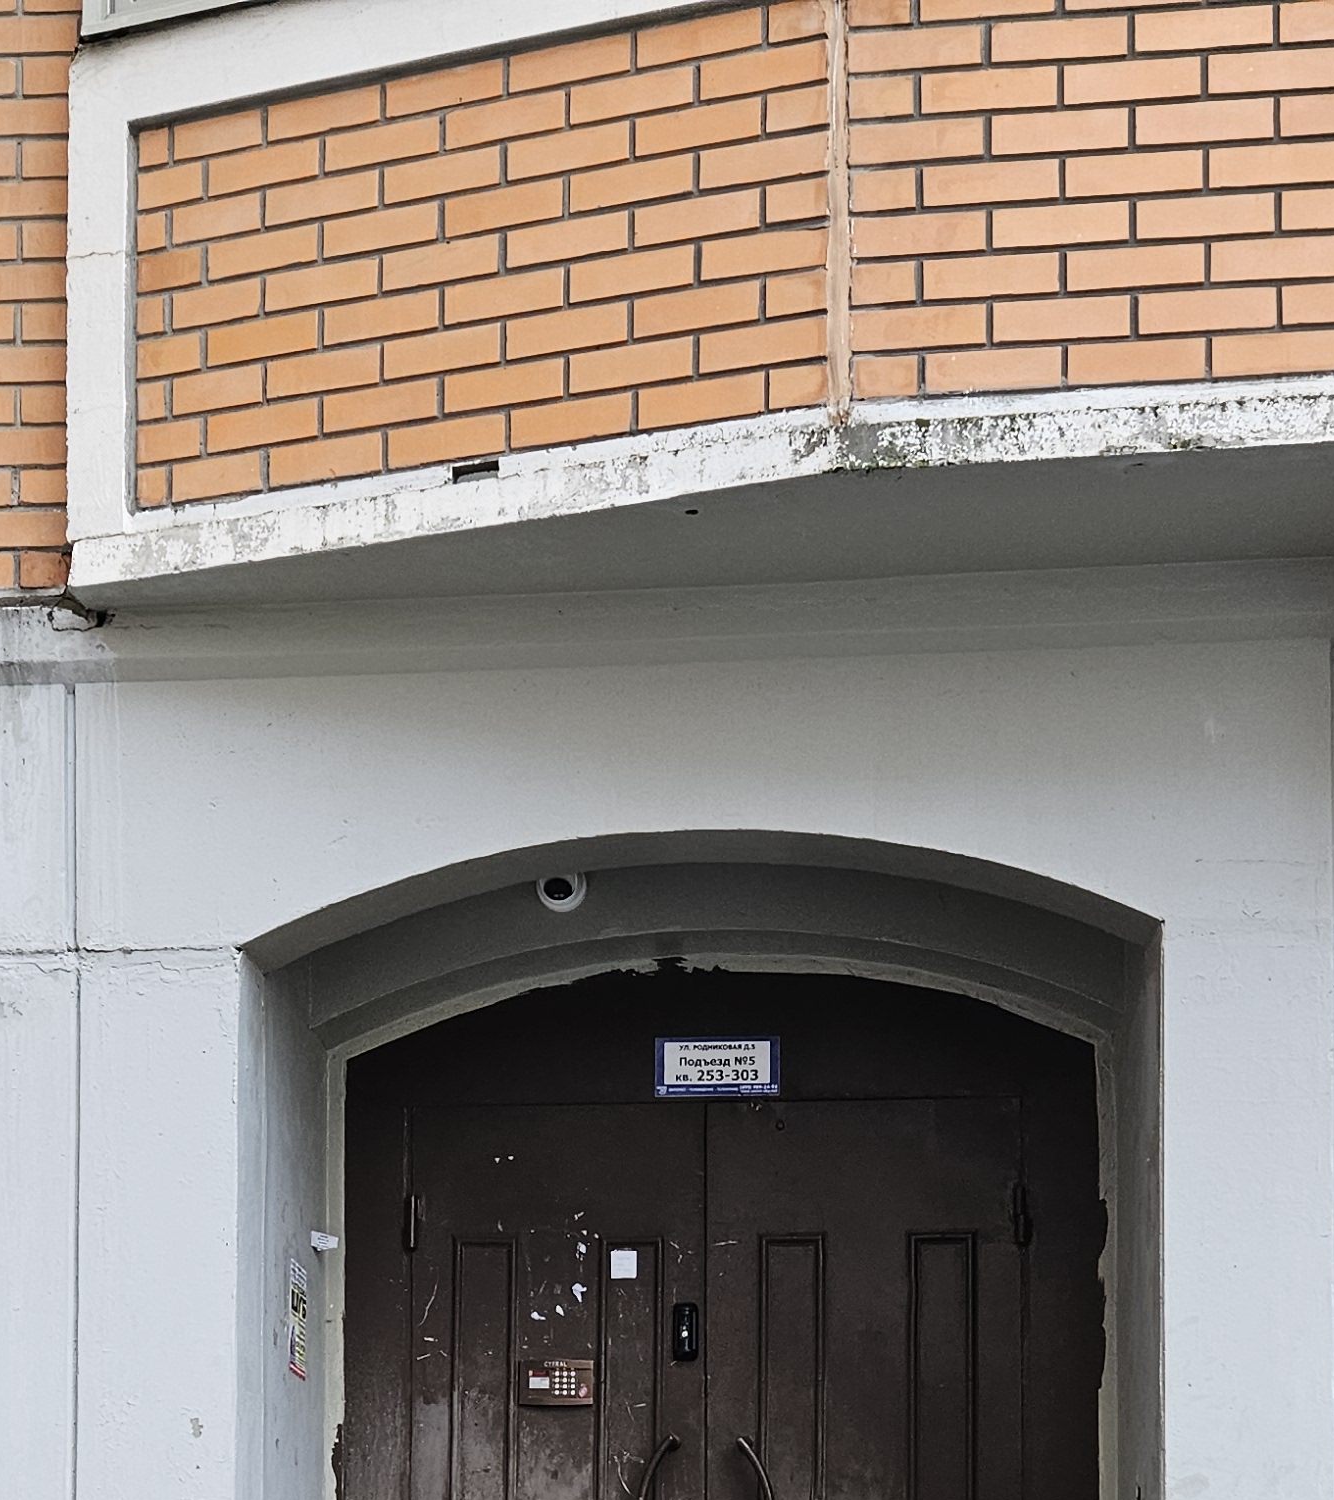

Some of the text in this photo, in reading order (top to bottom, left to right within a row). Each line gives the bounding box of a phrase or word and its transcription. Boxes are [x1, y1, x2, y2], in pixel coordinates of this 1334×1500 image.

[692, 1043, 742, 1051] РОДНИКОВАЯ
[679, 1056, 756, 1067] Подъезд №5
[675, 1069, 759, 1082] кв. 253-303
